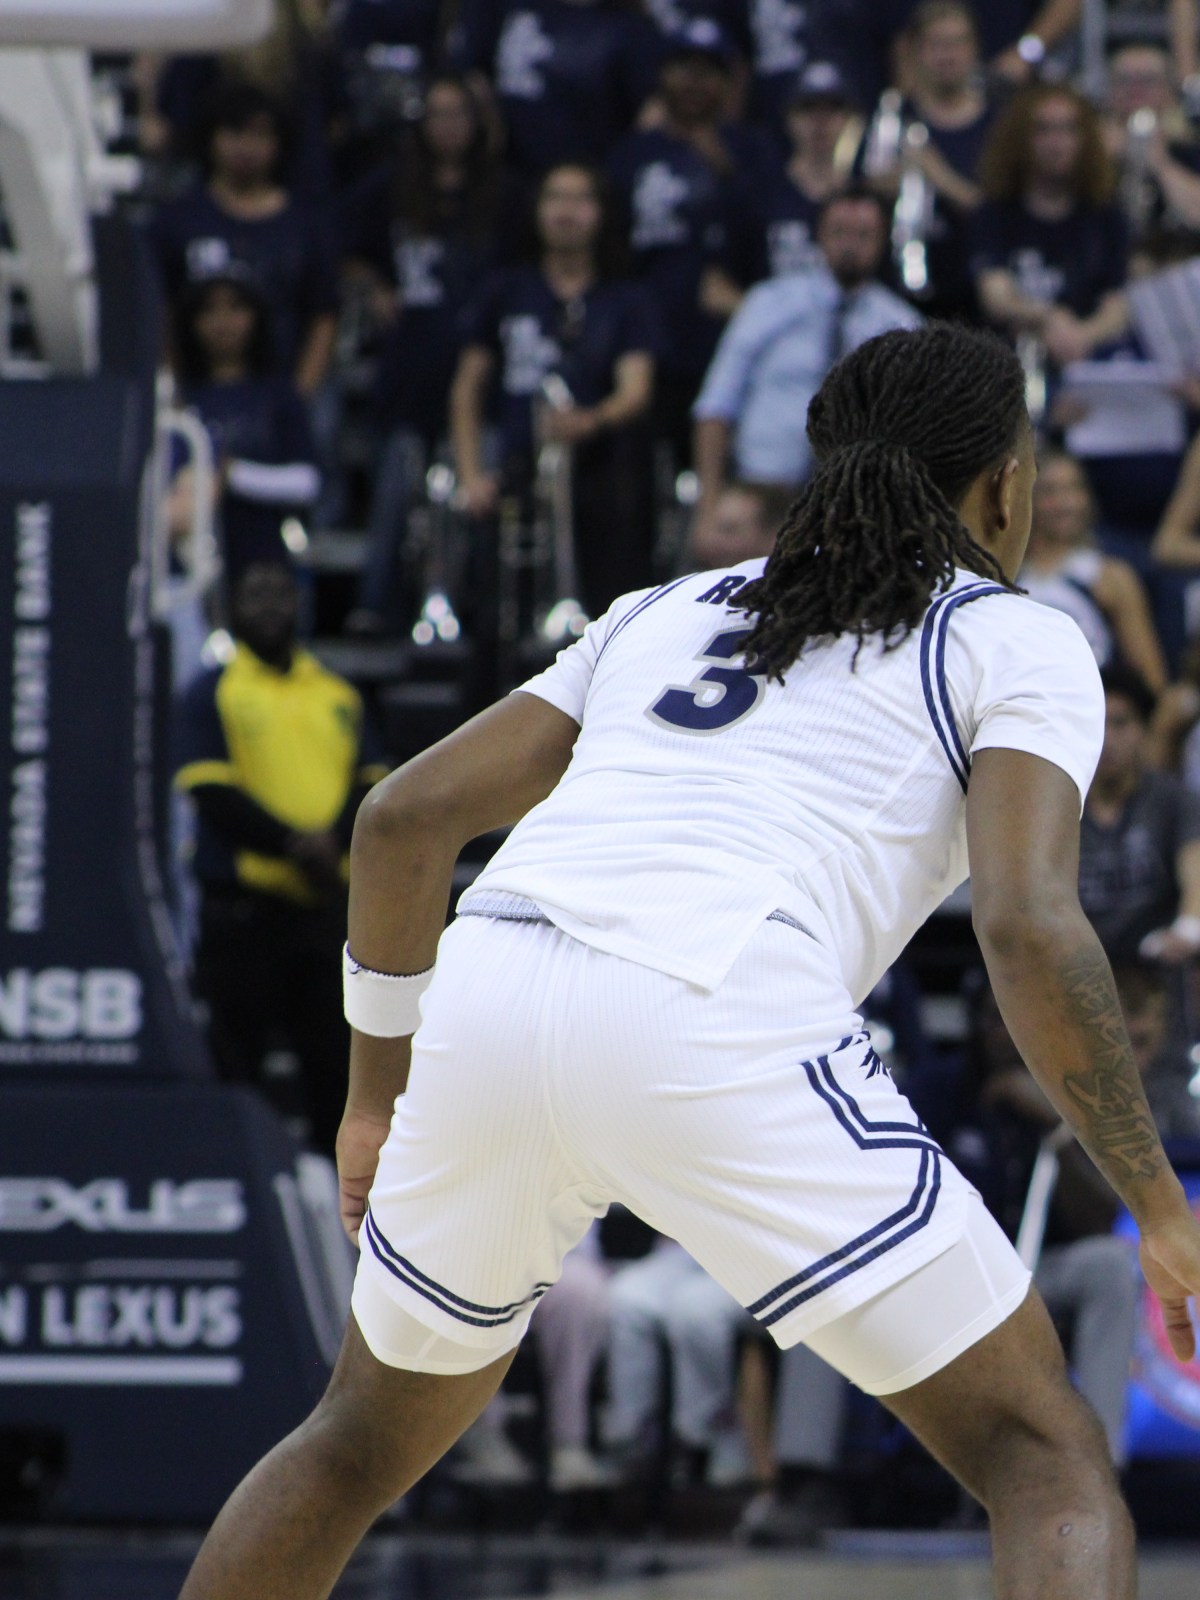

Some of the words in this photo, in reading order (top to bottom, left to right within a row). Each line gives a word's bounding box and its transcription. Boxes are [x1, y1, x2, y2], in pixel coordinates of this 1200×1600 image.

[644, 624, 768, 737] 3
[0, 967, 142, 1039] NSB
[42, 1284, 241, 1347] LEXUS
